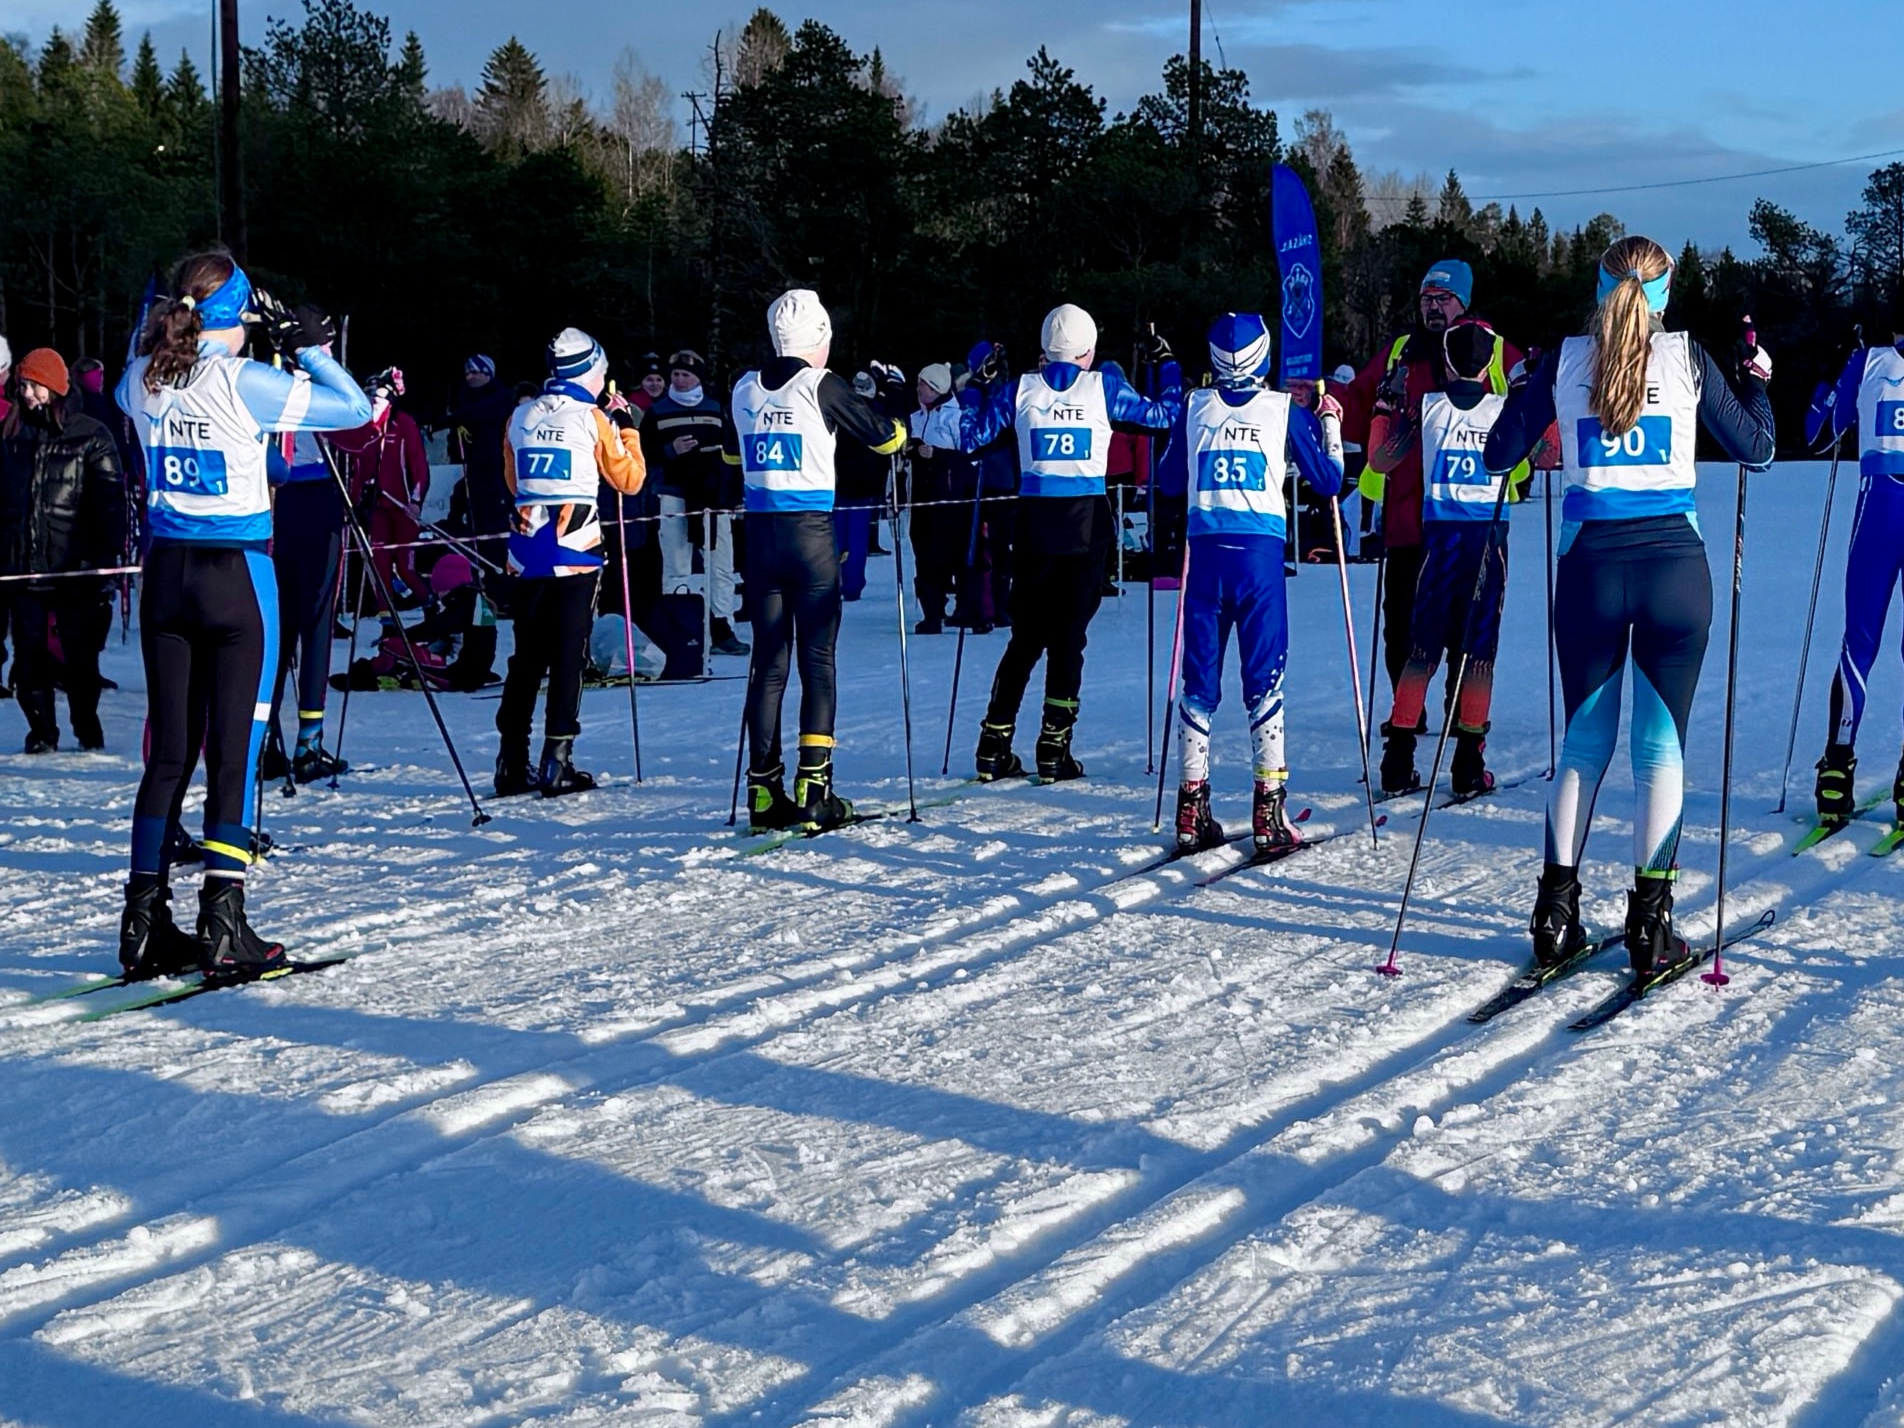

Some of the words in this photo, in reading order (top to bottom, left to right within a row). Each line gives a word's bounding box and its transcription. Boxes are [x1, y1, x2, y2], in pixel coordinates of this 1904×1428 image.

[763, 411, 794, 425] NTE
[1053, 409, 1085, 422] NTE
[169, 419, 211, 440] NTE
[536, 429, 565, 442] NTE
[1224, 427, 1261, 442] NTE
[1456, 430, 1488, 445] NTE
[1043, 433, 1075, 456] 78
[1600, 426, 1645, 457] 90
[527, 453, 554, 474] 77
[756, 441, 784, 465] 84
[163, 455, 200, 487] 89
[1213, 457, 1247, 483] 85
[1446, 456, 1476, 478] 79
